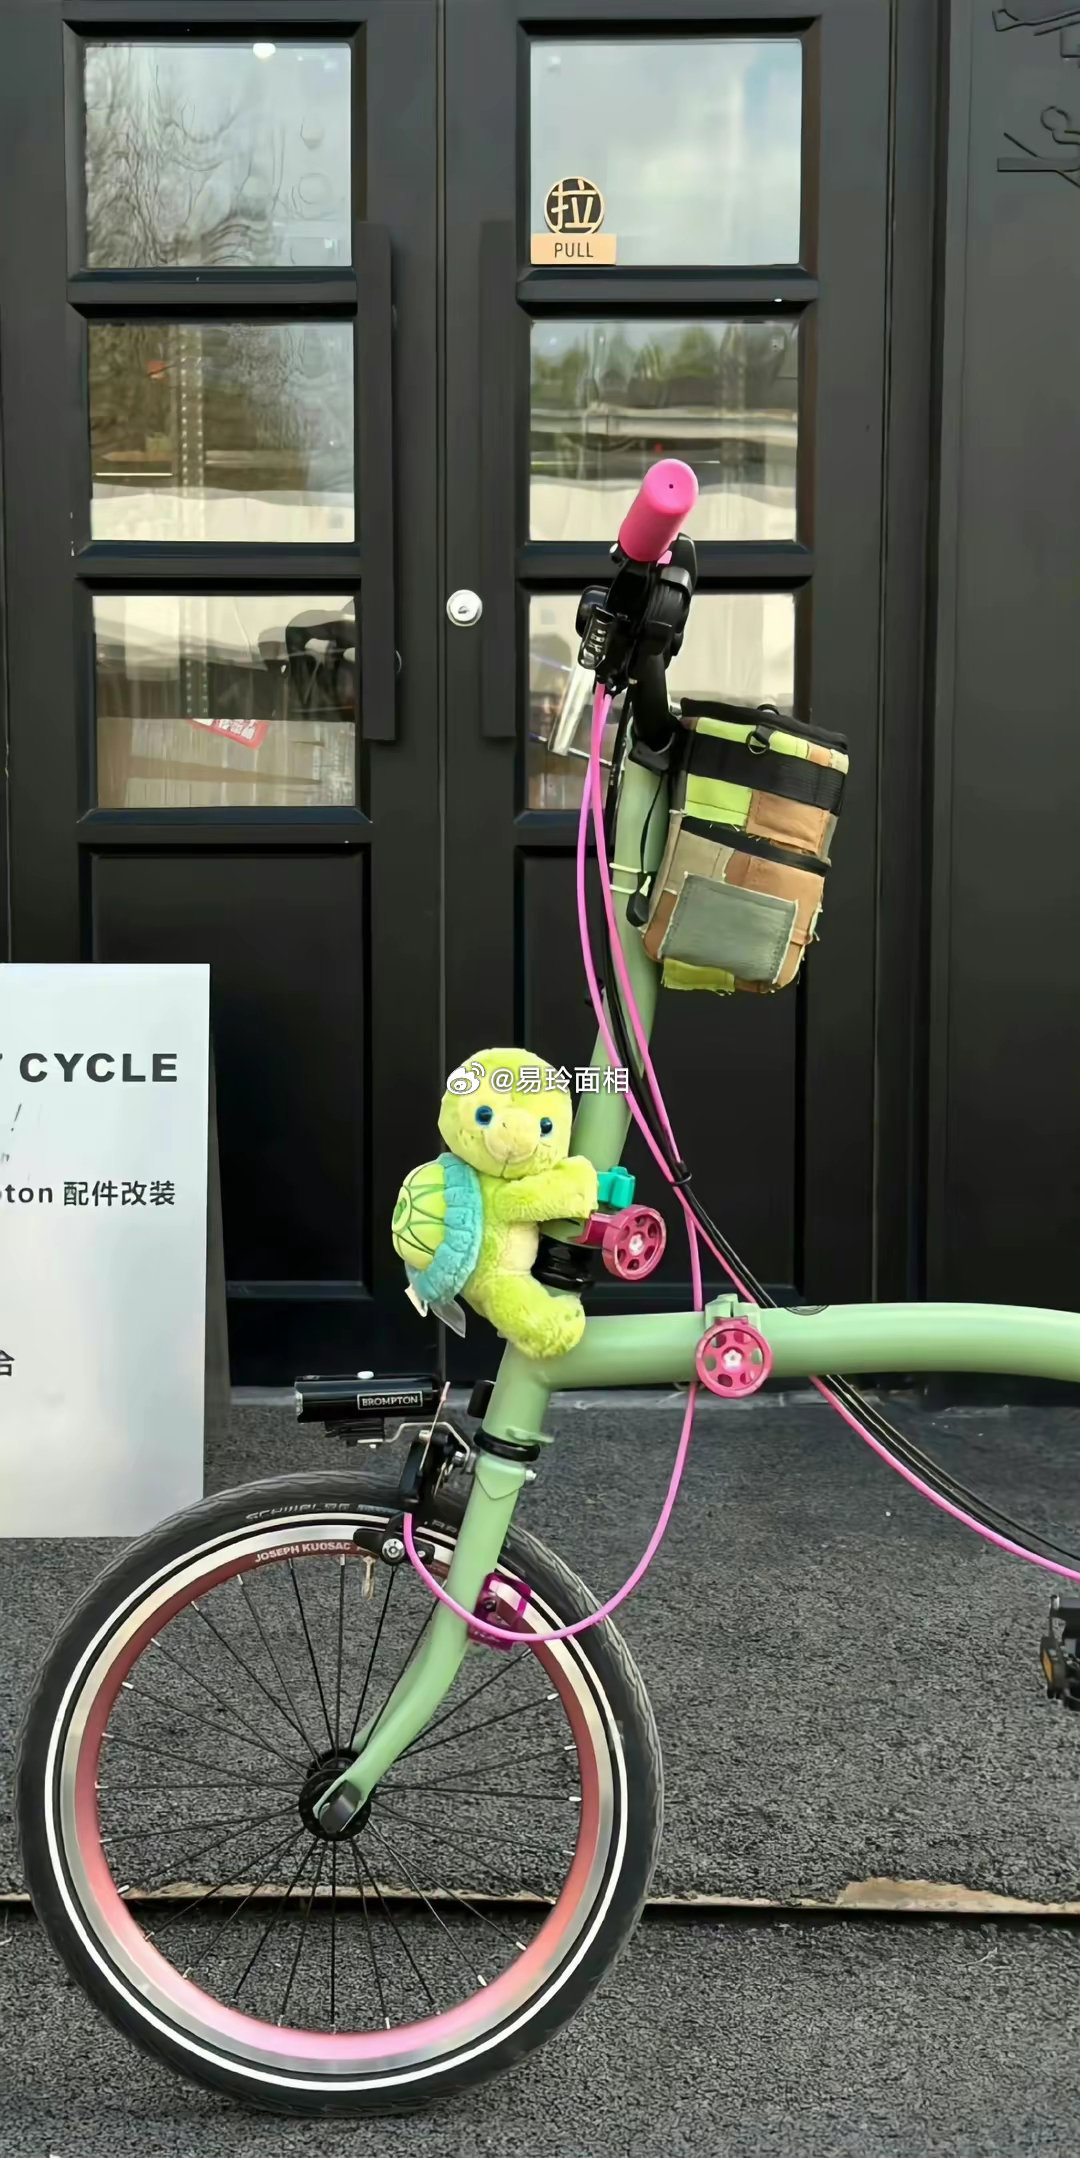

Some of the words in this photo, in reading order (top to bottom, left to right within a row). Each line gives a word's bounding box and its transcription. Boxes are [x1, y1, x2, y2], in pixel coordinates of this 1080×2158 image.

[551, 178, 598, 230] 拉
[554, 241, 594, 258] PULL
[19, 1052, 178, 1083] CYCLE
[0, 1184, 53, 1203] ton
[63, 1180, 176, 1207] 配件改装
[361, 1395, 419, 1407] BROMPTON
[255, 1544, 300, 1563] JOSEPH
[302, 1541, 351, 1554] KUOSAC
